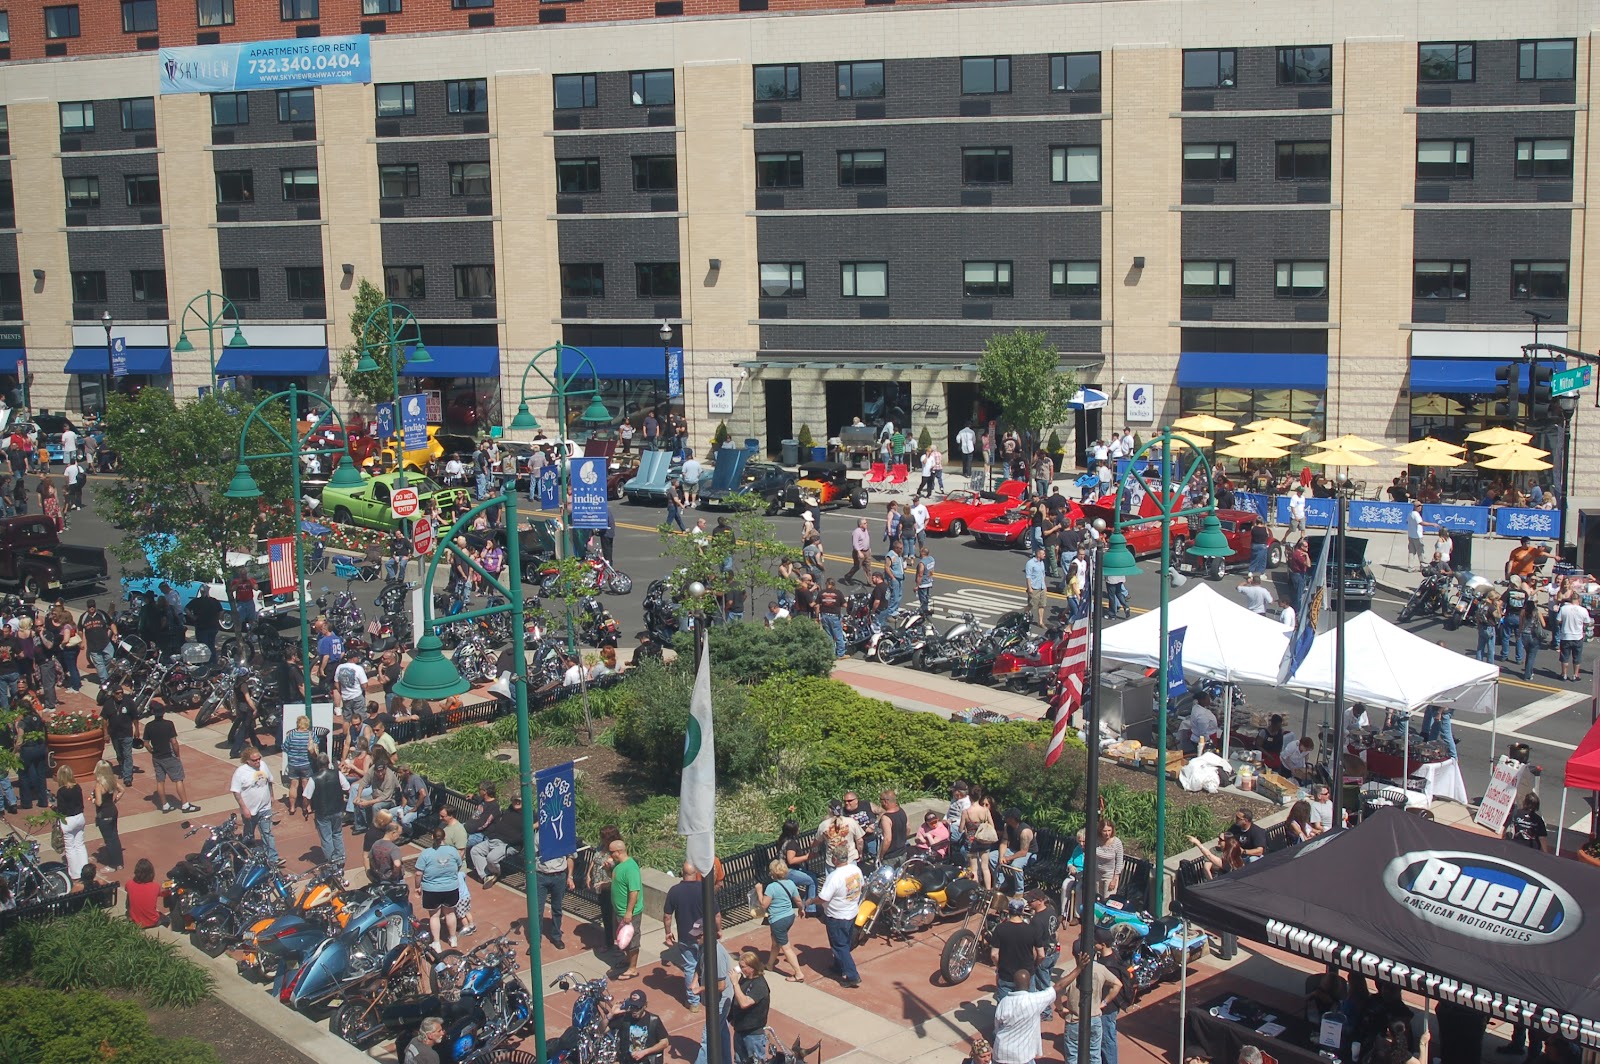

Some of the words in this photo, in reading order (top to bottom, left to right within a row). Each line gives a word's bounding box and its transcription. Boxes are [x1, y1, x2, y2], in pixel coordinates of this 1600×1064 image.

[250, 45, 310, 57] APARTMENTS
[312, 44, 330, 53] FOR
[333, 42, 358, 51] RENT
[179, 60, 229, 79] SKYVIEW
[248, 53, 361, 74] 732.340.0404
[711, 402, 729, 410] indigo
[404, 422, 426, 433] indigo
[573, 494, 605, 506] indigo
[397, 505, 414, 513] ENTER
[417, 539, 429, 549] ENTER
[1411, 857, 1555, 930] Buell
[1402, 895, 1455, 919] AMERICAN
[1456, 913, 1533, 942] MOTORCYCLES
